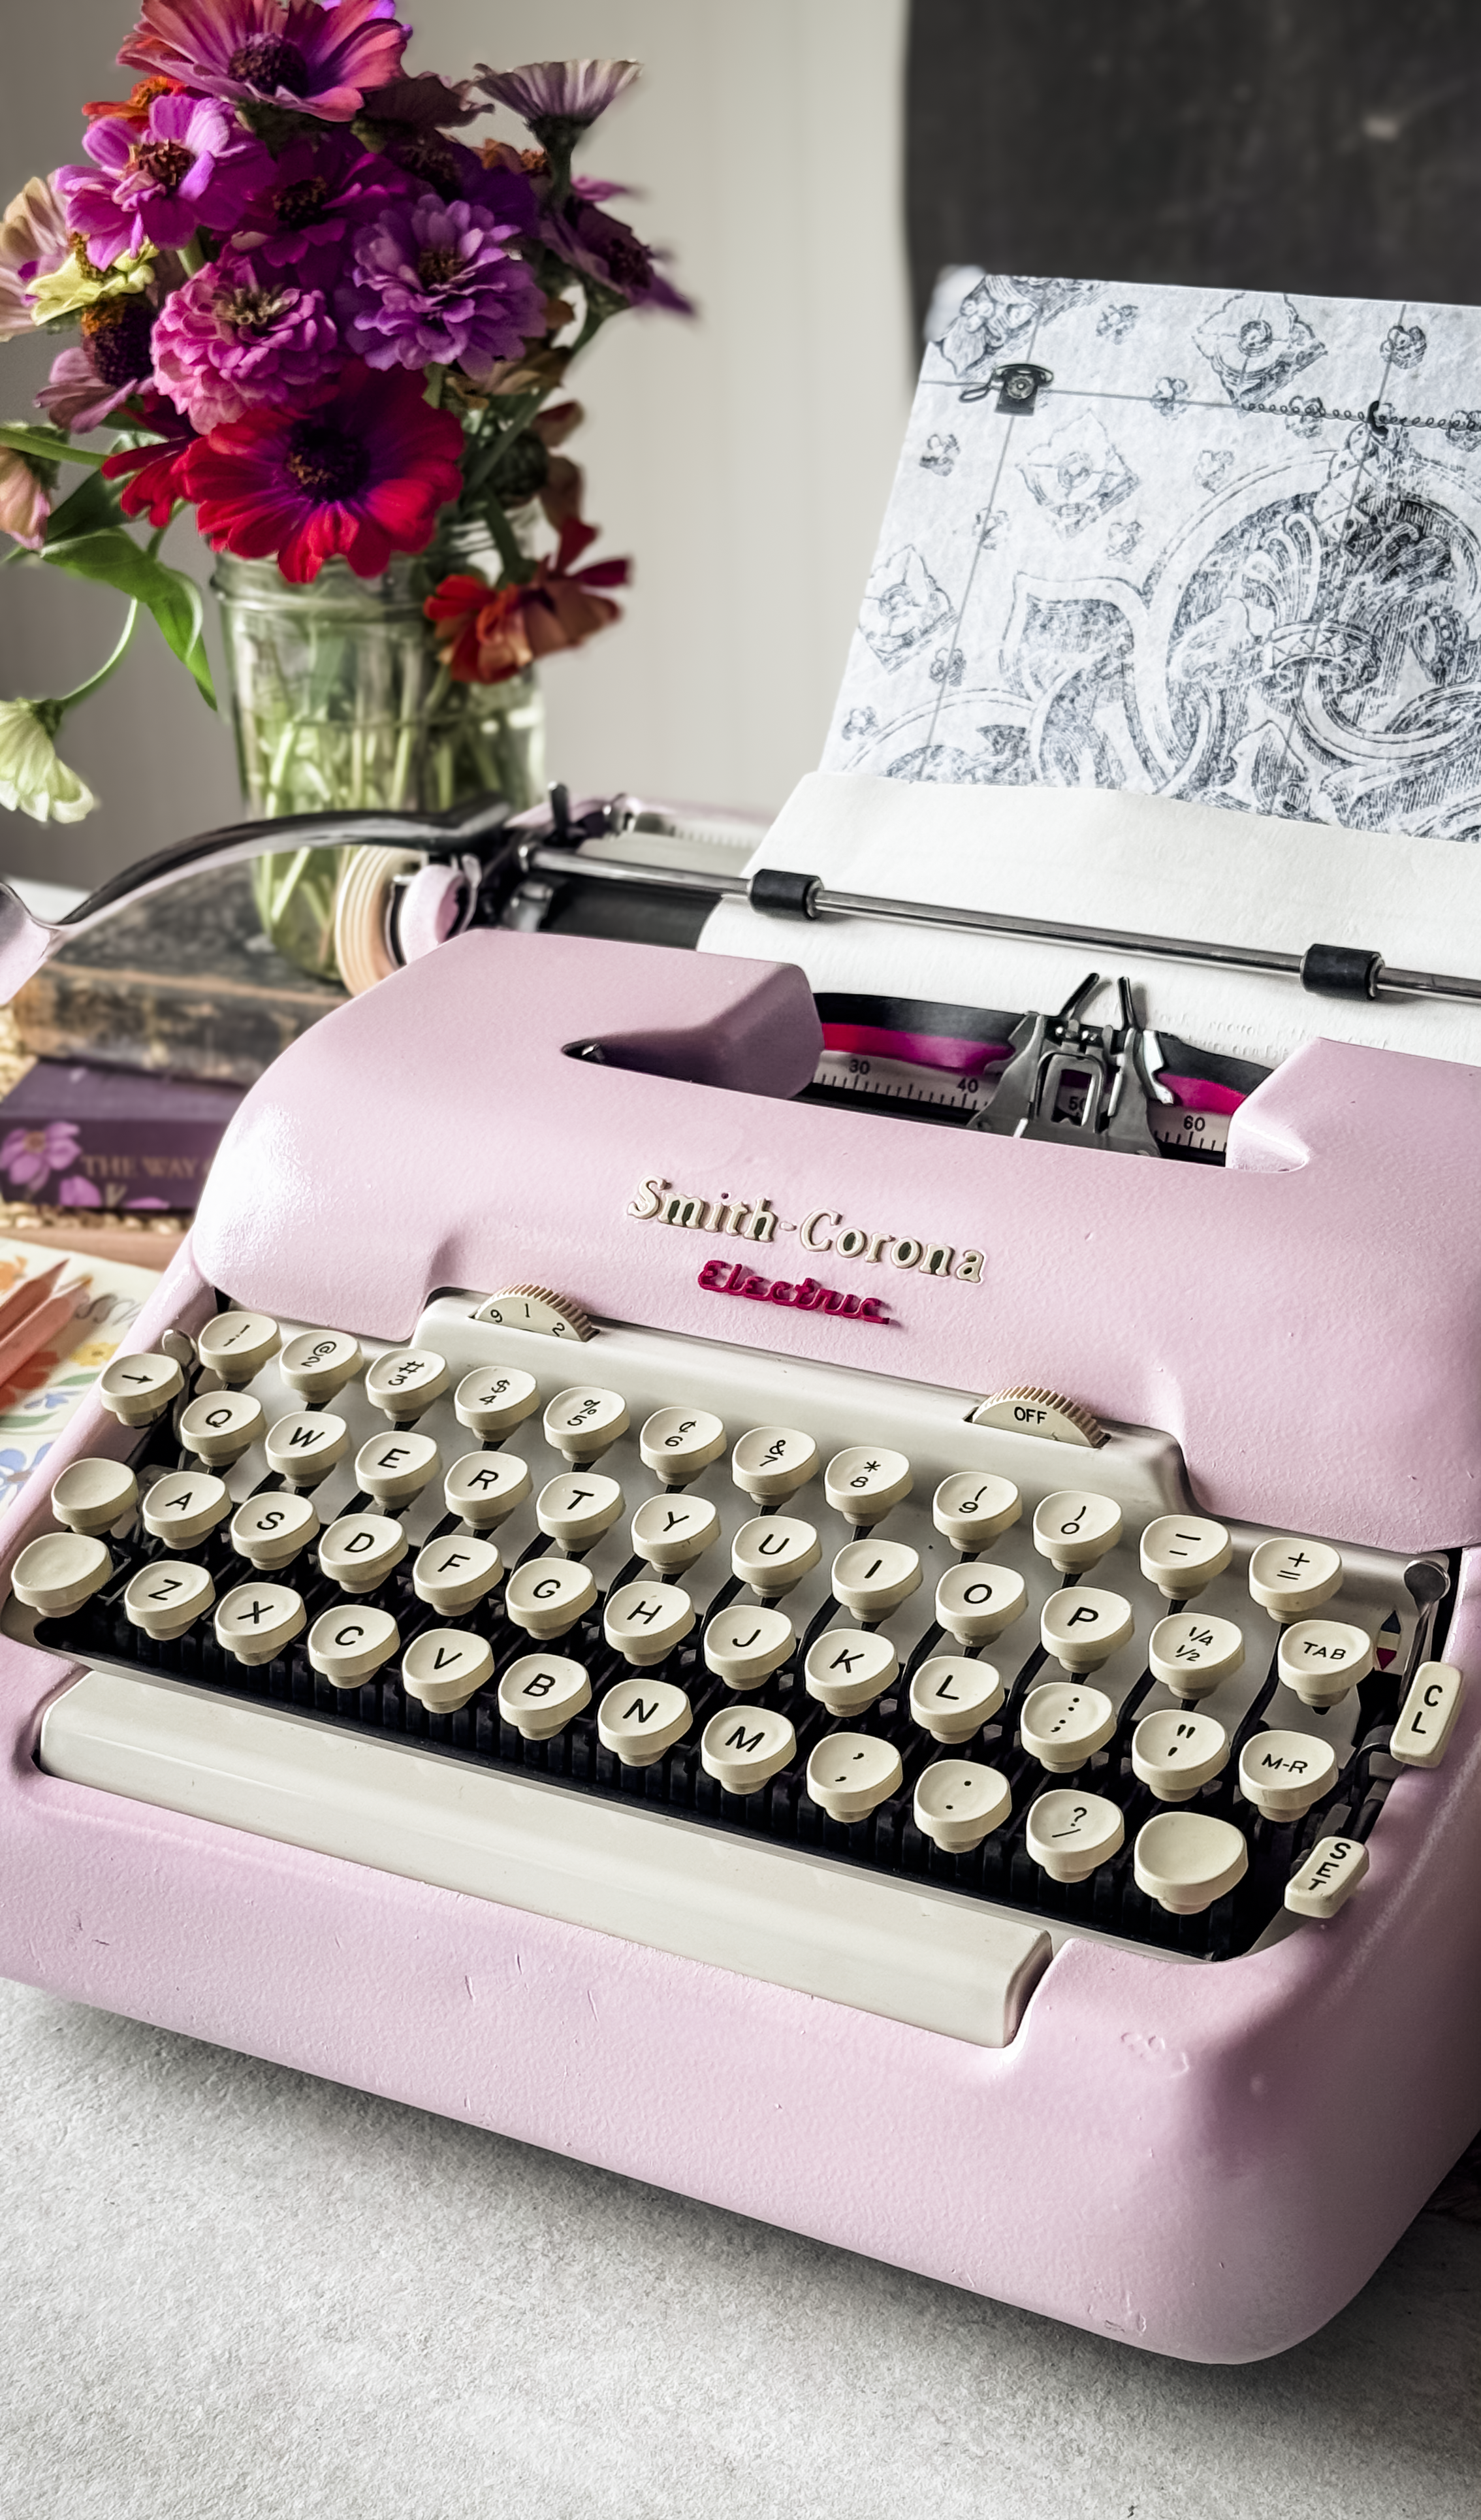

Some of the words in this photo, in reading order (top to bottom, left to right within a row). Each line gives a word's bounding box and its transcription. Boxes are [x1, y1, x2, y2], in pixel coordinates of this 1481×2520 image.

[849, 1058, 870, 1074] 30
[957, 1078, 978, 1093] 40
[1183, 1115, 1205, 1132] 60
[81, 1155, 136, 1176] THE
[142, 1156, 198, 1177] WAY
[627, 1176, 987, 1284] Smith-Corona
[697, 1260, 891, 1325] Electric
[525, 1303, 530, 1318] 1
[552, 1322, 565, 1337] 2
[313, 1341, 337, 1357] @
[300, 1355, 321, 1367] 2
[398, 1361, 424, 1374] #
[388, 1374, 408, 1386] 3
[491, 1379, 510, 1393] $
[479, 1395, 497, 1405] 4
[579, 1399, 601, 1415] %
[205, 1409, 232, 1428] Q
[567, 1415, 587, 1427] 5
[1013, 1406, 1047, 1425] OFF
[289, 1427, 325, 1447] W
[664, 1436, 683, 1447] 6
[769, 1439, 786, 1456] &
[377, 1448, 411, 1469] E
[759, 1455, 778, 1467] 7
[467, 1469, 499, 1491] R
[850, 1476, 868, 1488] 8
[165, 1492, 193, 1511] A
[567, 1489, 594, 1510] T
[958, 1501, 979, 1513] 9
[256, 1511, 285, 1530] S
[663, 1511, 690, 1532] Y
[343, 1532, 375, 1553] D
[758, 1534, 790, 1555] U
[437, 1553, 470, 1572] F
[864, 1559, 883, 1579] I
[1288, 1552, 1310, 1568] +
[148, 1579, 183, 1601] Z
[532, 1579, 561, 1599] G
[963, 1583, 993, 1604] O
[237, 1600, 274, 1624] X
[626, 1600, 663, 1624] H
[1067, 1606, 1099, 1626] P
[334, 1626, 364, 1646] C
[732, 1629, 761, 1647] J
[434, 1647, 463, 1670] V
[1303, 1641, 1346, 1660] TAB
[829, 1649, 865, 1673] K
[522, 1673, 556, 1697] B
[935, 1674, 959, 1700] L
[622, 1698, 659, 1723] N
[724, 1726, 763, 1753] M
[1261, 1753, 1308, 1774] M-R
[1070, 1807, 1087, 1827] ?
[1308, 1842, 1351, 1890] SET
